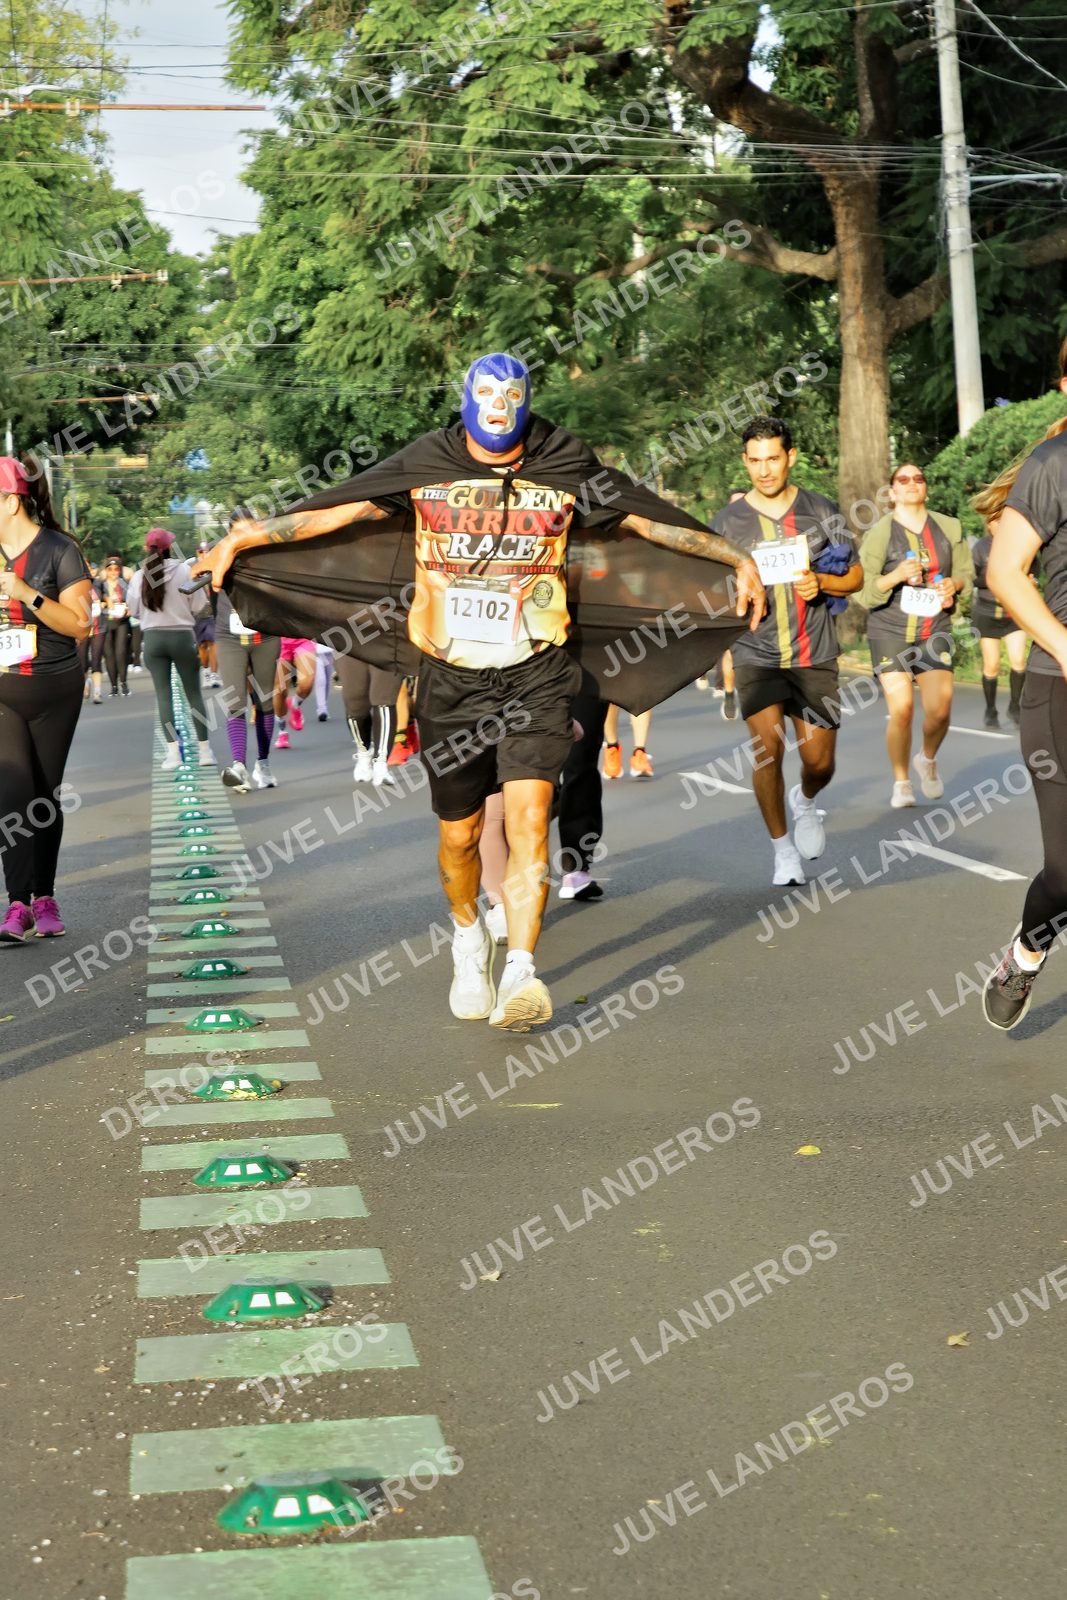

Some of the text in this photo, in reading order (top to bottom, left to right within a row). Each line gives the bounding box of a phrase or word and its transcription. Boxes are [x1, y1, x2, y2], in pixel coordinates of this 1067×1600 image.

[423, 485, 564, 511] THE GOLDEN
[447, 533, 538, 560] RACE
[761, 551, 796, 569] 4231
[450, 596, 510, 621] 12102
[908, 590, 935, 604] 3979
